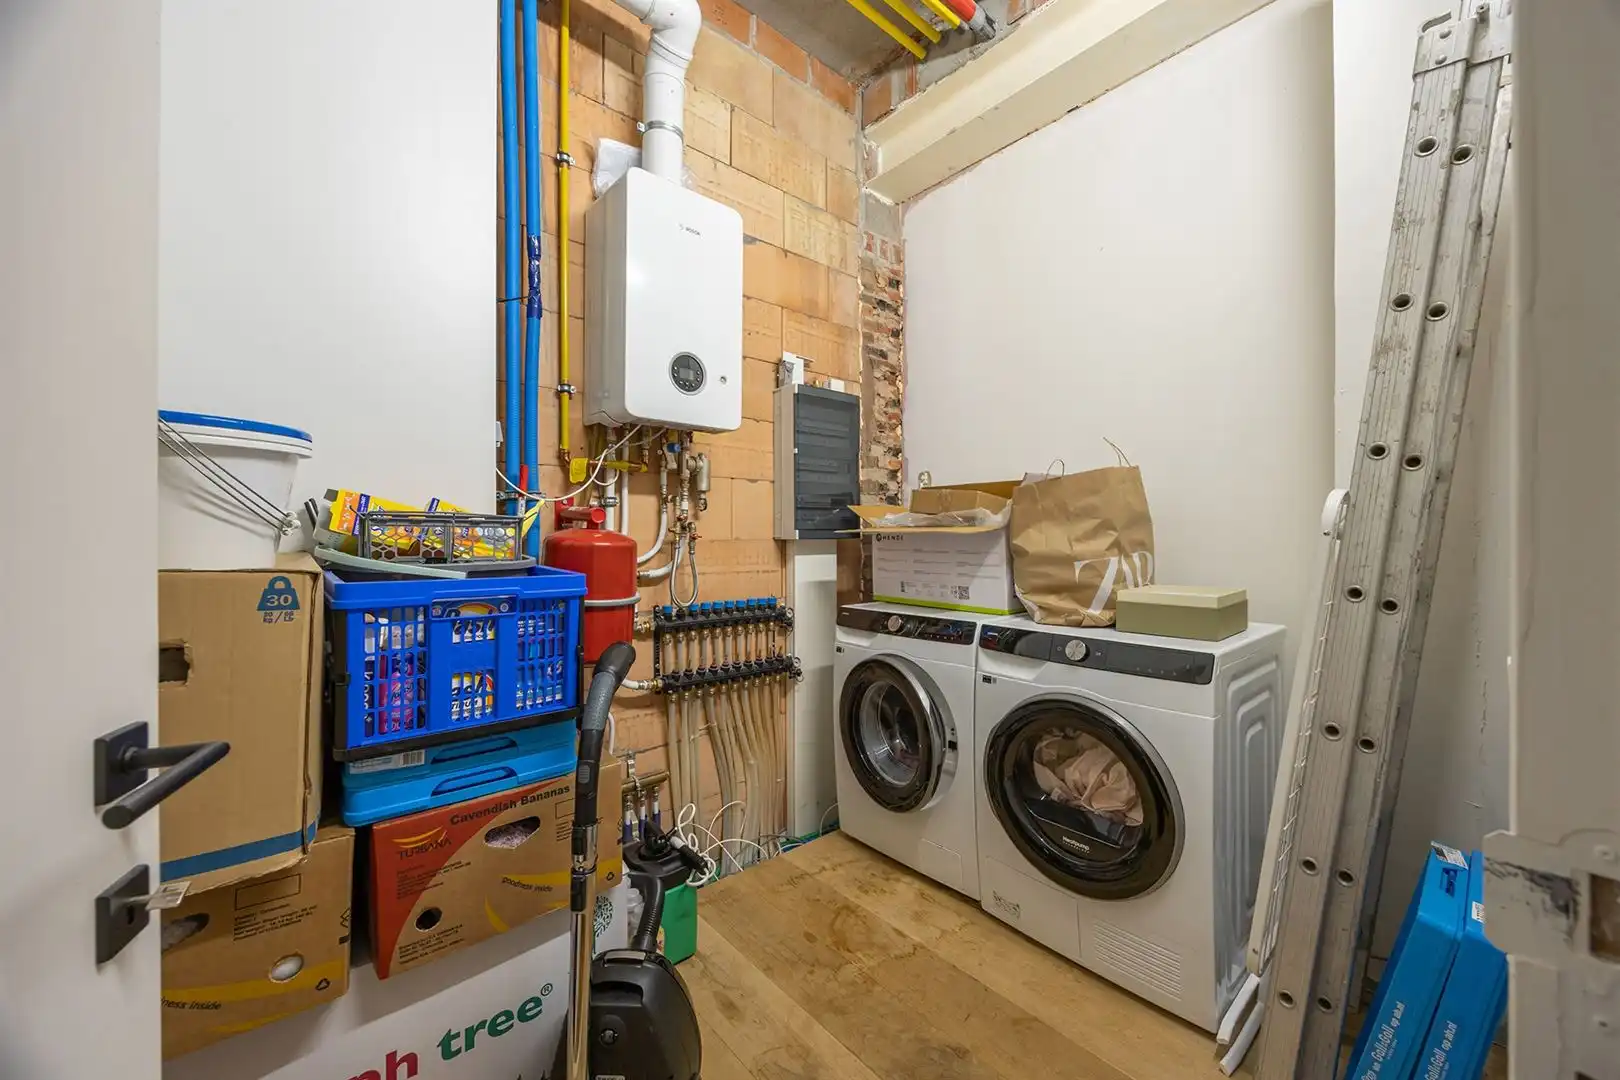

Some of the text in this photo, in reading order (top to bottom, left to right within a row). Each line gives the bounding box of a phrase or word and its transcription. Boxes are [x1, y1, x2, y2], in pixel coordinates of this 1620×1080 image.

[266, 594, 293, 607] 30
[450, 784, 571, 826] Cavendish Bananas
[188, 999, 222, 1010] inside
